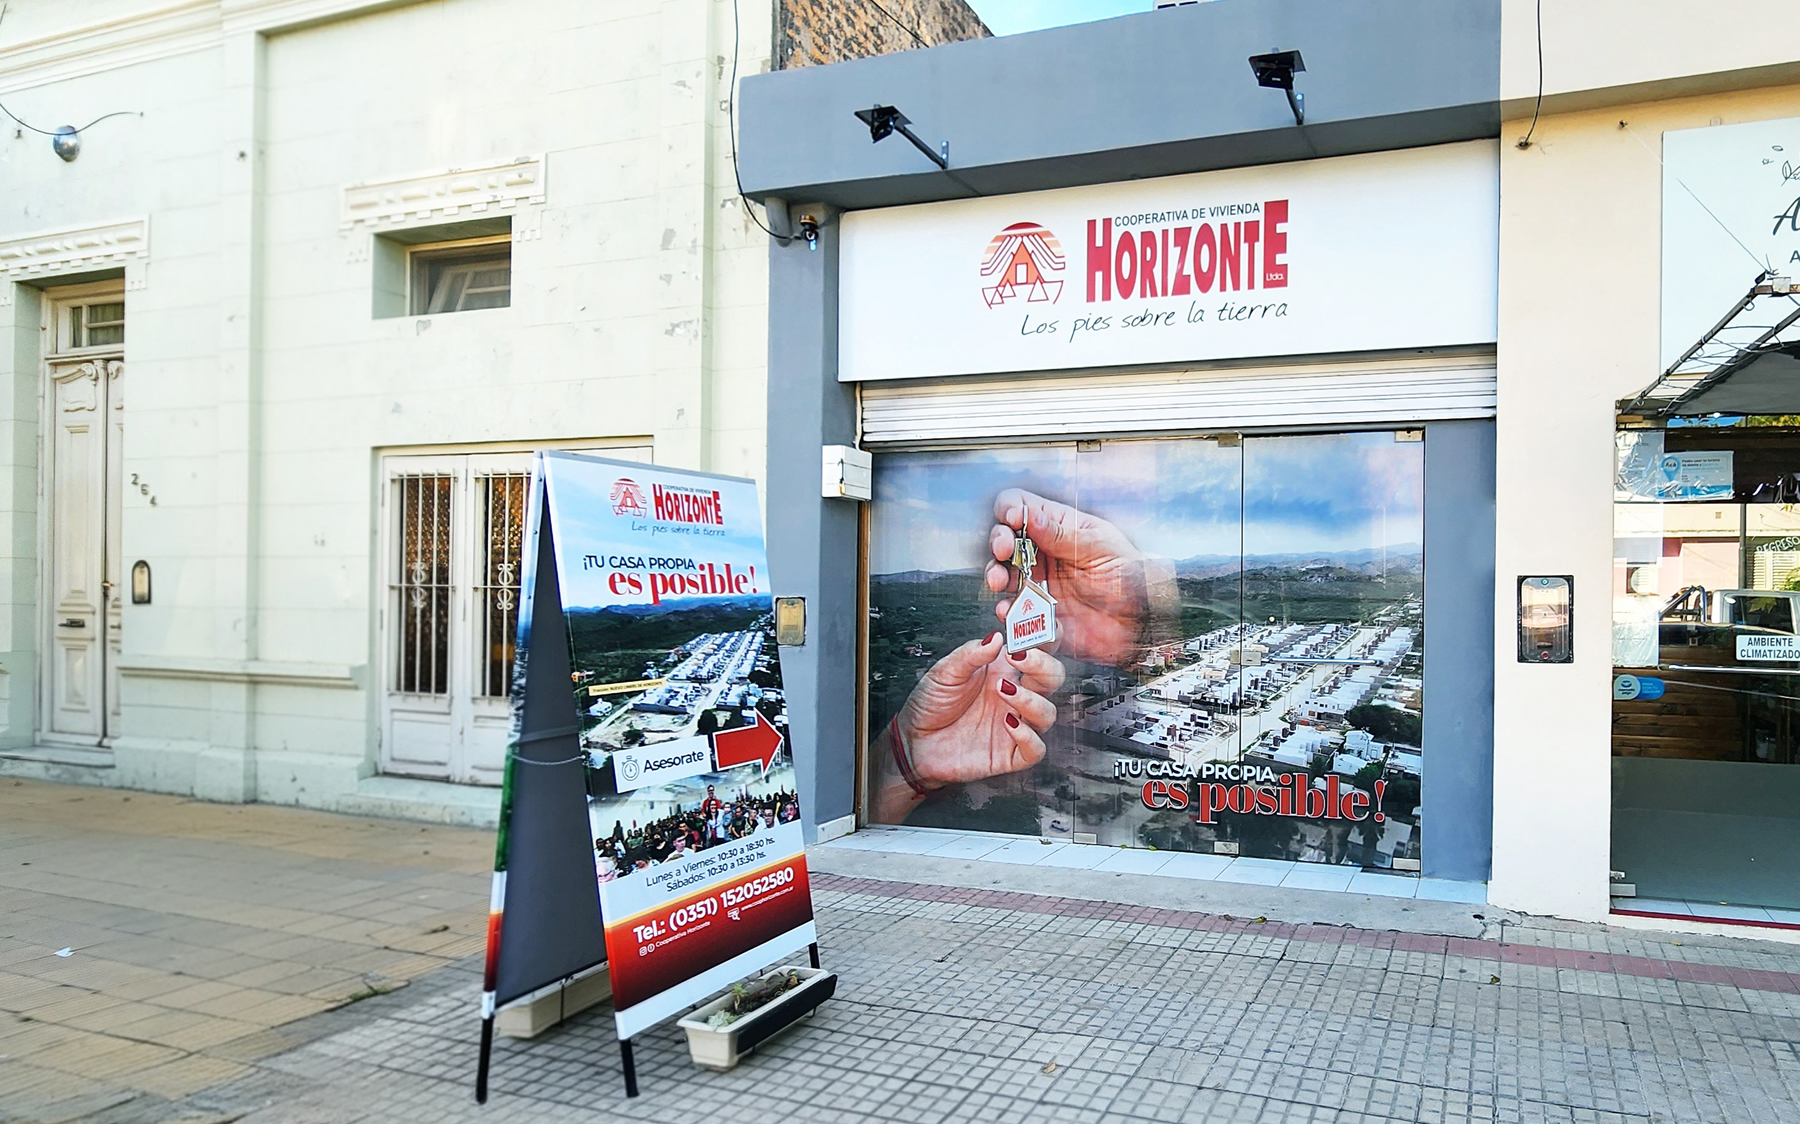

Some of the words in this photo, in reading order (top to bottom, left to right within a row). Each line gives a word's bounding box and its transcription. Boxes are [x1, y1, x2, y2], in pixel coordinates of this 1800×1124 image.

[1114, 210, 1188, 227] COOPERATIVA
[1191, 207, 1206, 220] DE
[1208, 202, 1261, 218] VIVIENDA
[1086, 199, 1289, 303] HORIZONTE
[1265, 272, 1285, 282] Ltda.
[1021, 314, 1060, 336] Los
[1069, 312, 1113, 343] pies
[1120, 305, 1176, 328] sobre
[1187, 300, 1205, 325] la
[1217, 300, 1288, 321] tierra
[662, 484, 689, 492] COOPERATIVA
[652, 483, 723, 525] HORIZONTE
[631, 521, 647, 531] Los
[652, 525, 667, 536] pies
[671, 526, 690, 535] sobre
[693, 525, 700, 535] la
[703, 528, 725, 536] tierra
[583, 555, 605, 570] ¡TU
[609, 555, 646, 569] CASA
[649, 557, 697, 570] PROPIA
[608, 571, 643, 596] es
[647, 562, 758, 606] posible!
[1013, 613, 1046, 640] HORIZONTE
[1740, 648, 1800, 659] CLIMATIZADO
[1747, 637, 1794, 647] AMBIENTE
[643, 750, 705, 773] Asesorate
[1113, 758, 1142, 777] ¡TU
[1146, 759, 1197, 778] CASA
[1201, 763, 1276, 783] PROPIA
[1140, 777, 1189, 809] es
[1196, 773, 1386, 825] posible!
[645, 871, 673, 887] Lunes
[675, 868, 681, 877] a
[683, 857, 716, 874] Viernes:
[717, 848, 738, 861] 10:30
[745, 839, 764, 851] 18:30
[765, 837, 776, 846] hs.
[666, 872, 705, 892] Sábados:
[707, 863, 728, 877] 10:30
[730, 861, 735, 869] a
[736, 854, 755, 866] 13:30
[756, 850, 767, 860] hs.
[633, 919, 667, 943] Tel.:
[668, 896, 718, 932] (0351)
[719, 866, 794, 908] 152052580
[655, 930, 687, 948] Cooperativa
[686, 920, 711, 935] Horizonte
